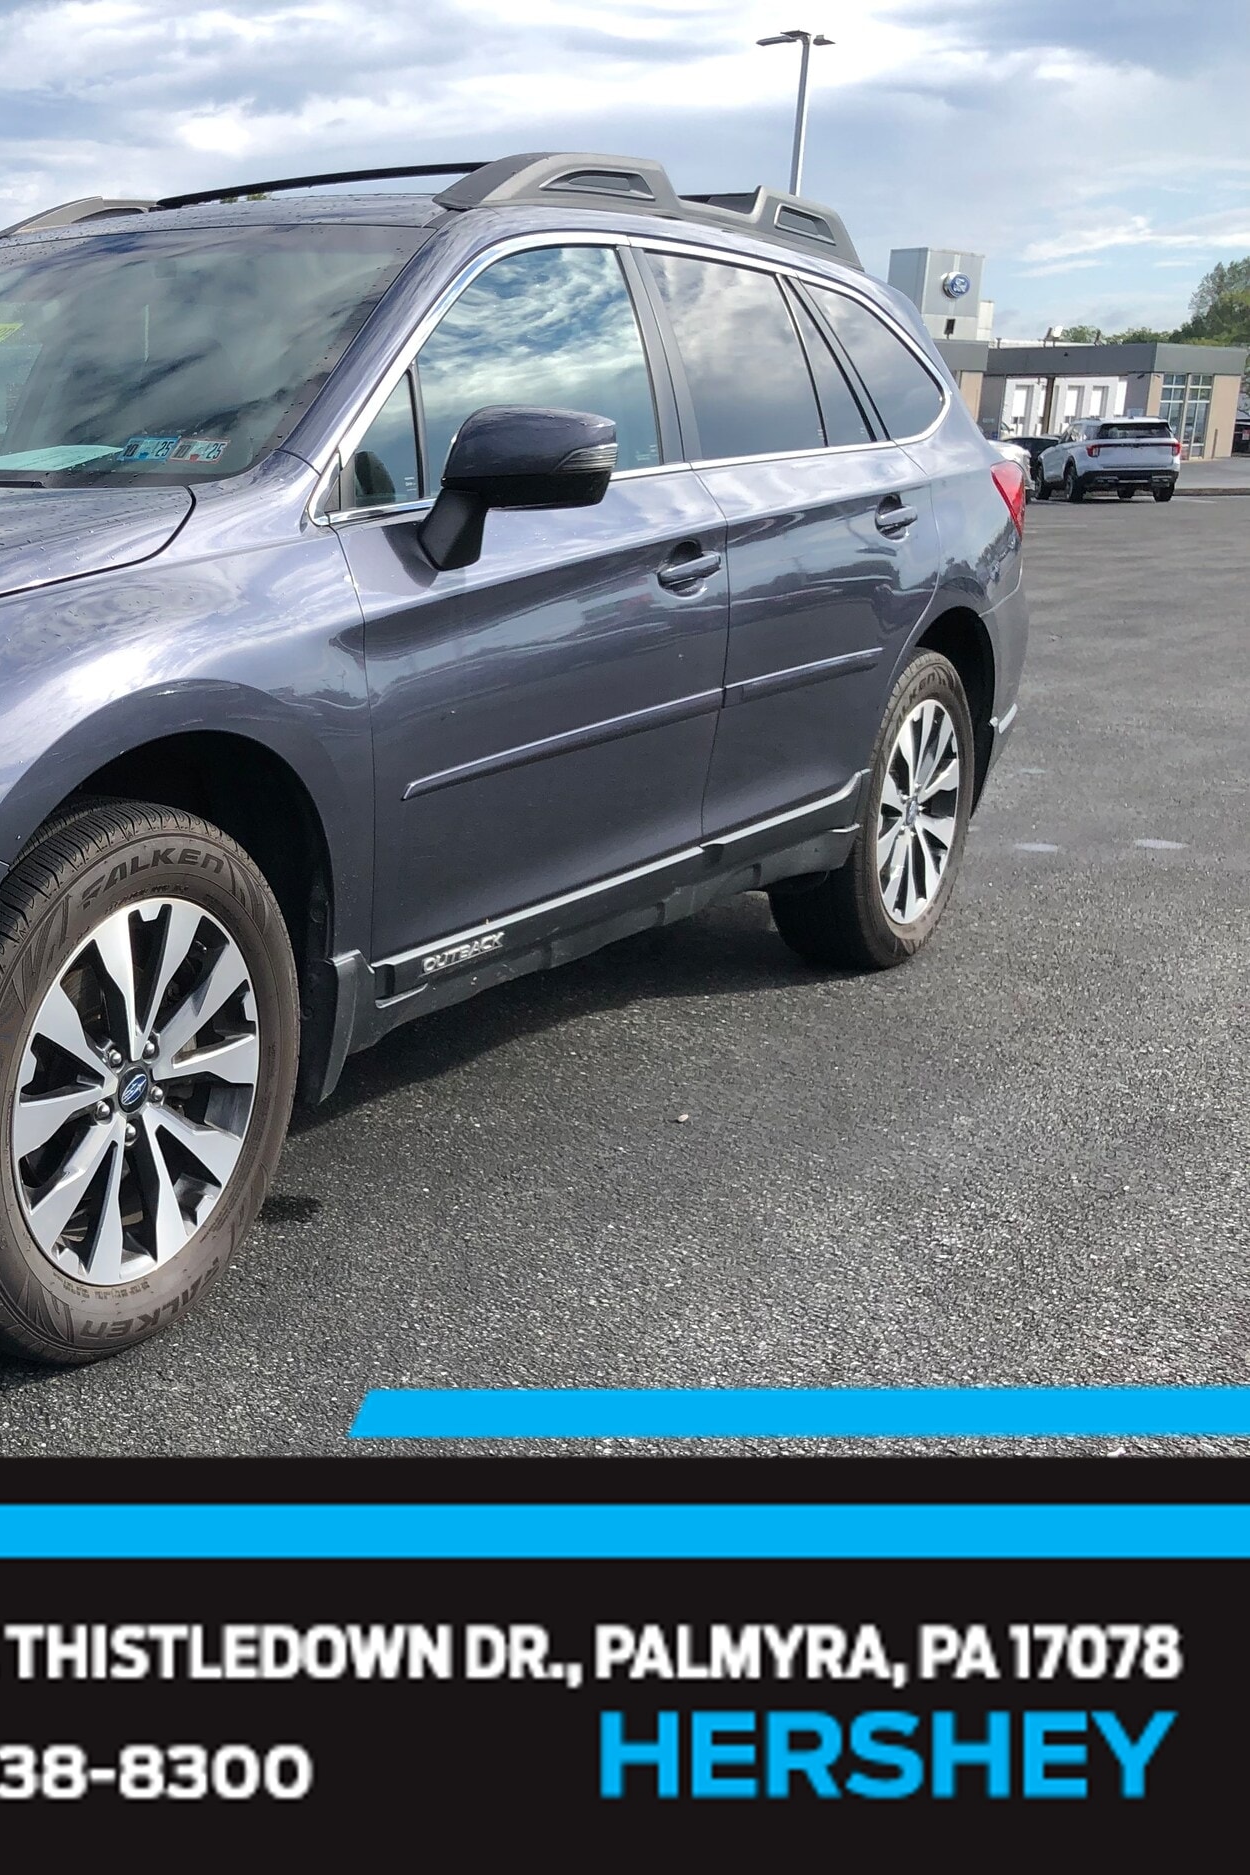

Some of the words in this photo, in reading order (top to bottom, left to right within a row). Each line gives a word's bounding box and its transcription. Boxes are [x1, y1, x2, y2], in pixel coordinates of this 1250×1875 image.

[123, 443, 139, 457] 10
[155, 441, 174, 457] 25
[206, 442, 225, 459] 25
[81, 847, 225, 911] FALKEN
[423, 931, 506, 972] OUTBACK
[80, 1257, 220, 1340] FALKEN
